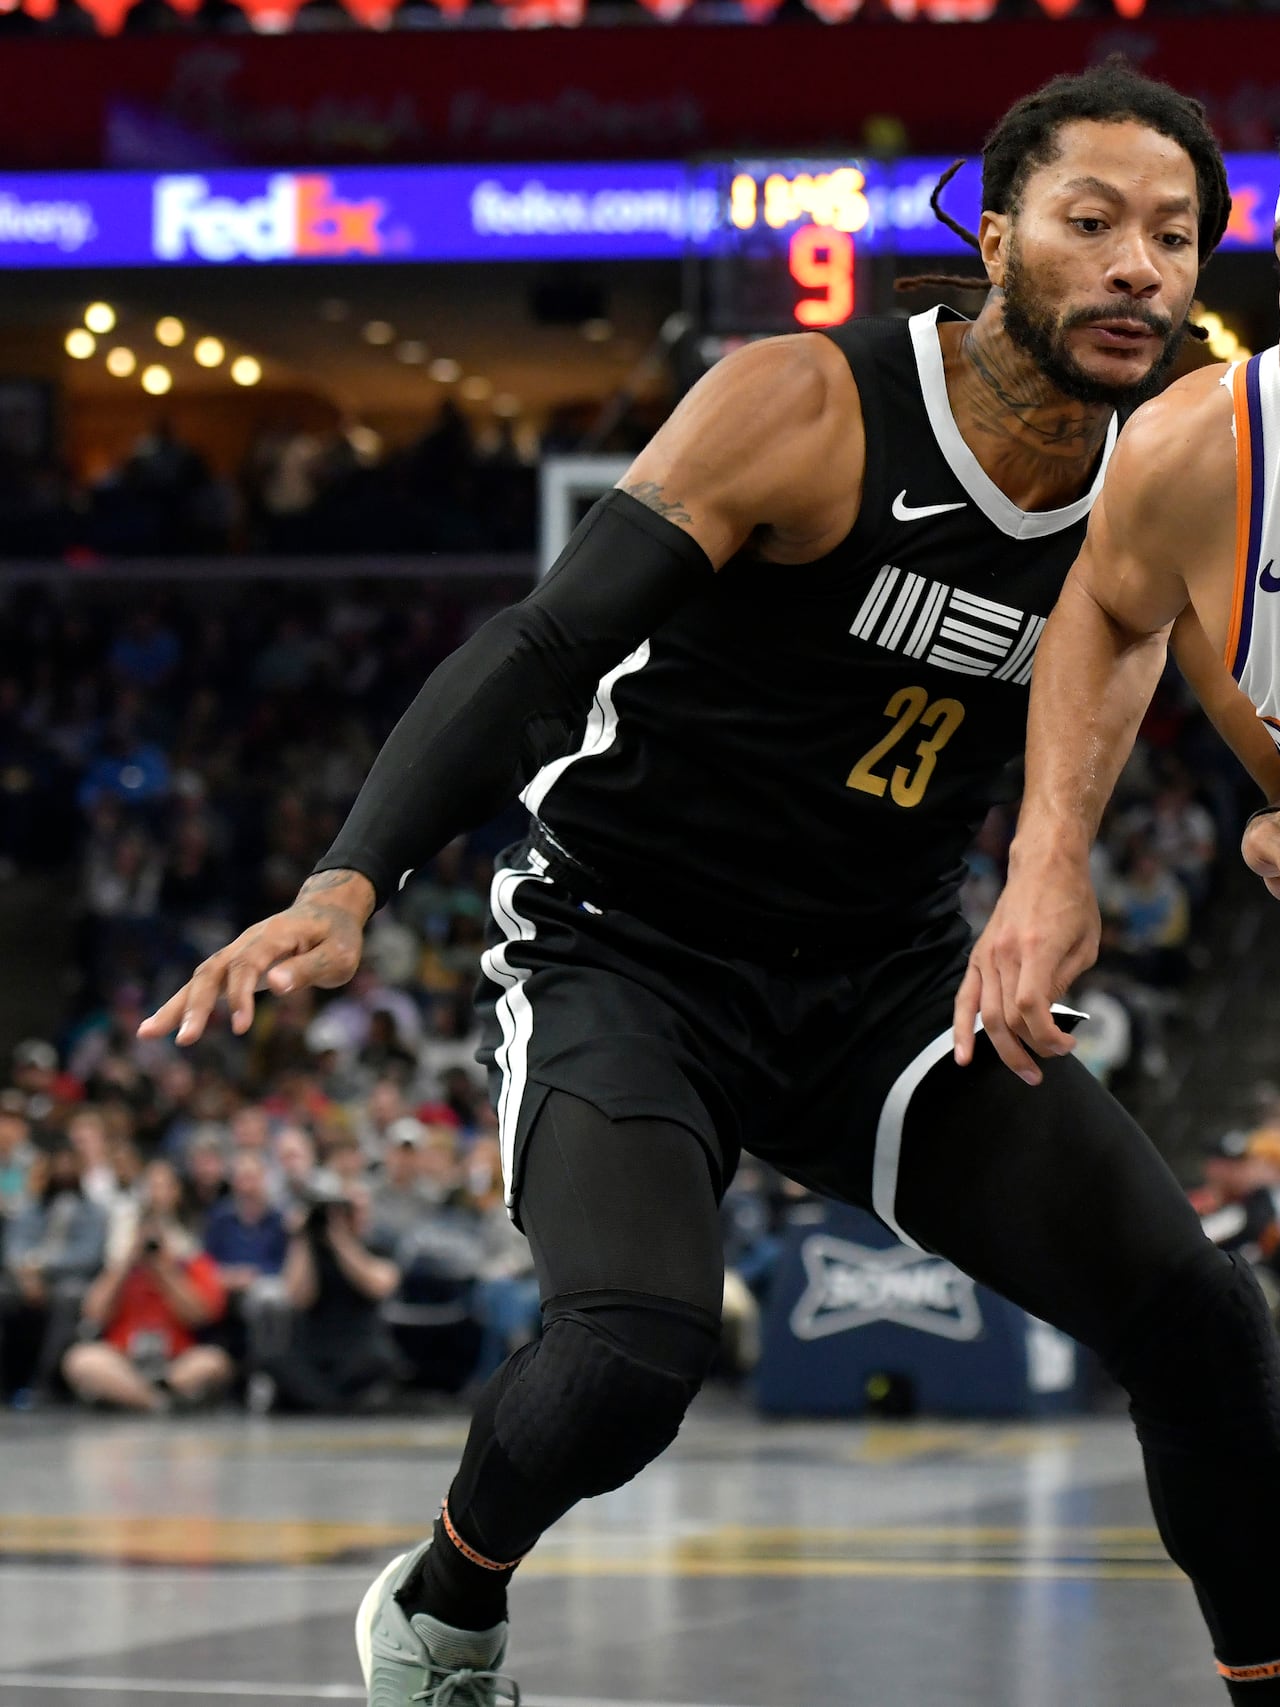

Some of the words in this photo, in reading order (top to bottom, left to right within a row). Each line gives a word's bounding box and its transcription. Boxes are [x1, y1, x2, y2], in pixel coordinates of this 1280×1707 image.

[153, 174, 383, 261] FedEx
[789, 224, 856, 327] 9
[846, 686, 965, 807] 23
